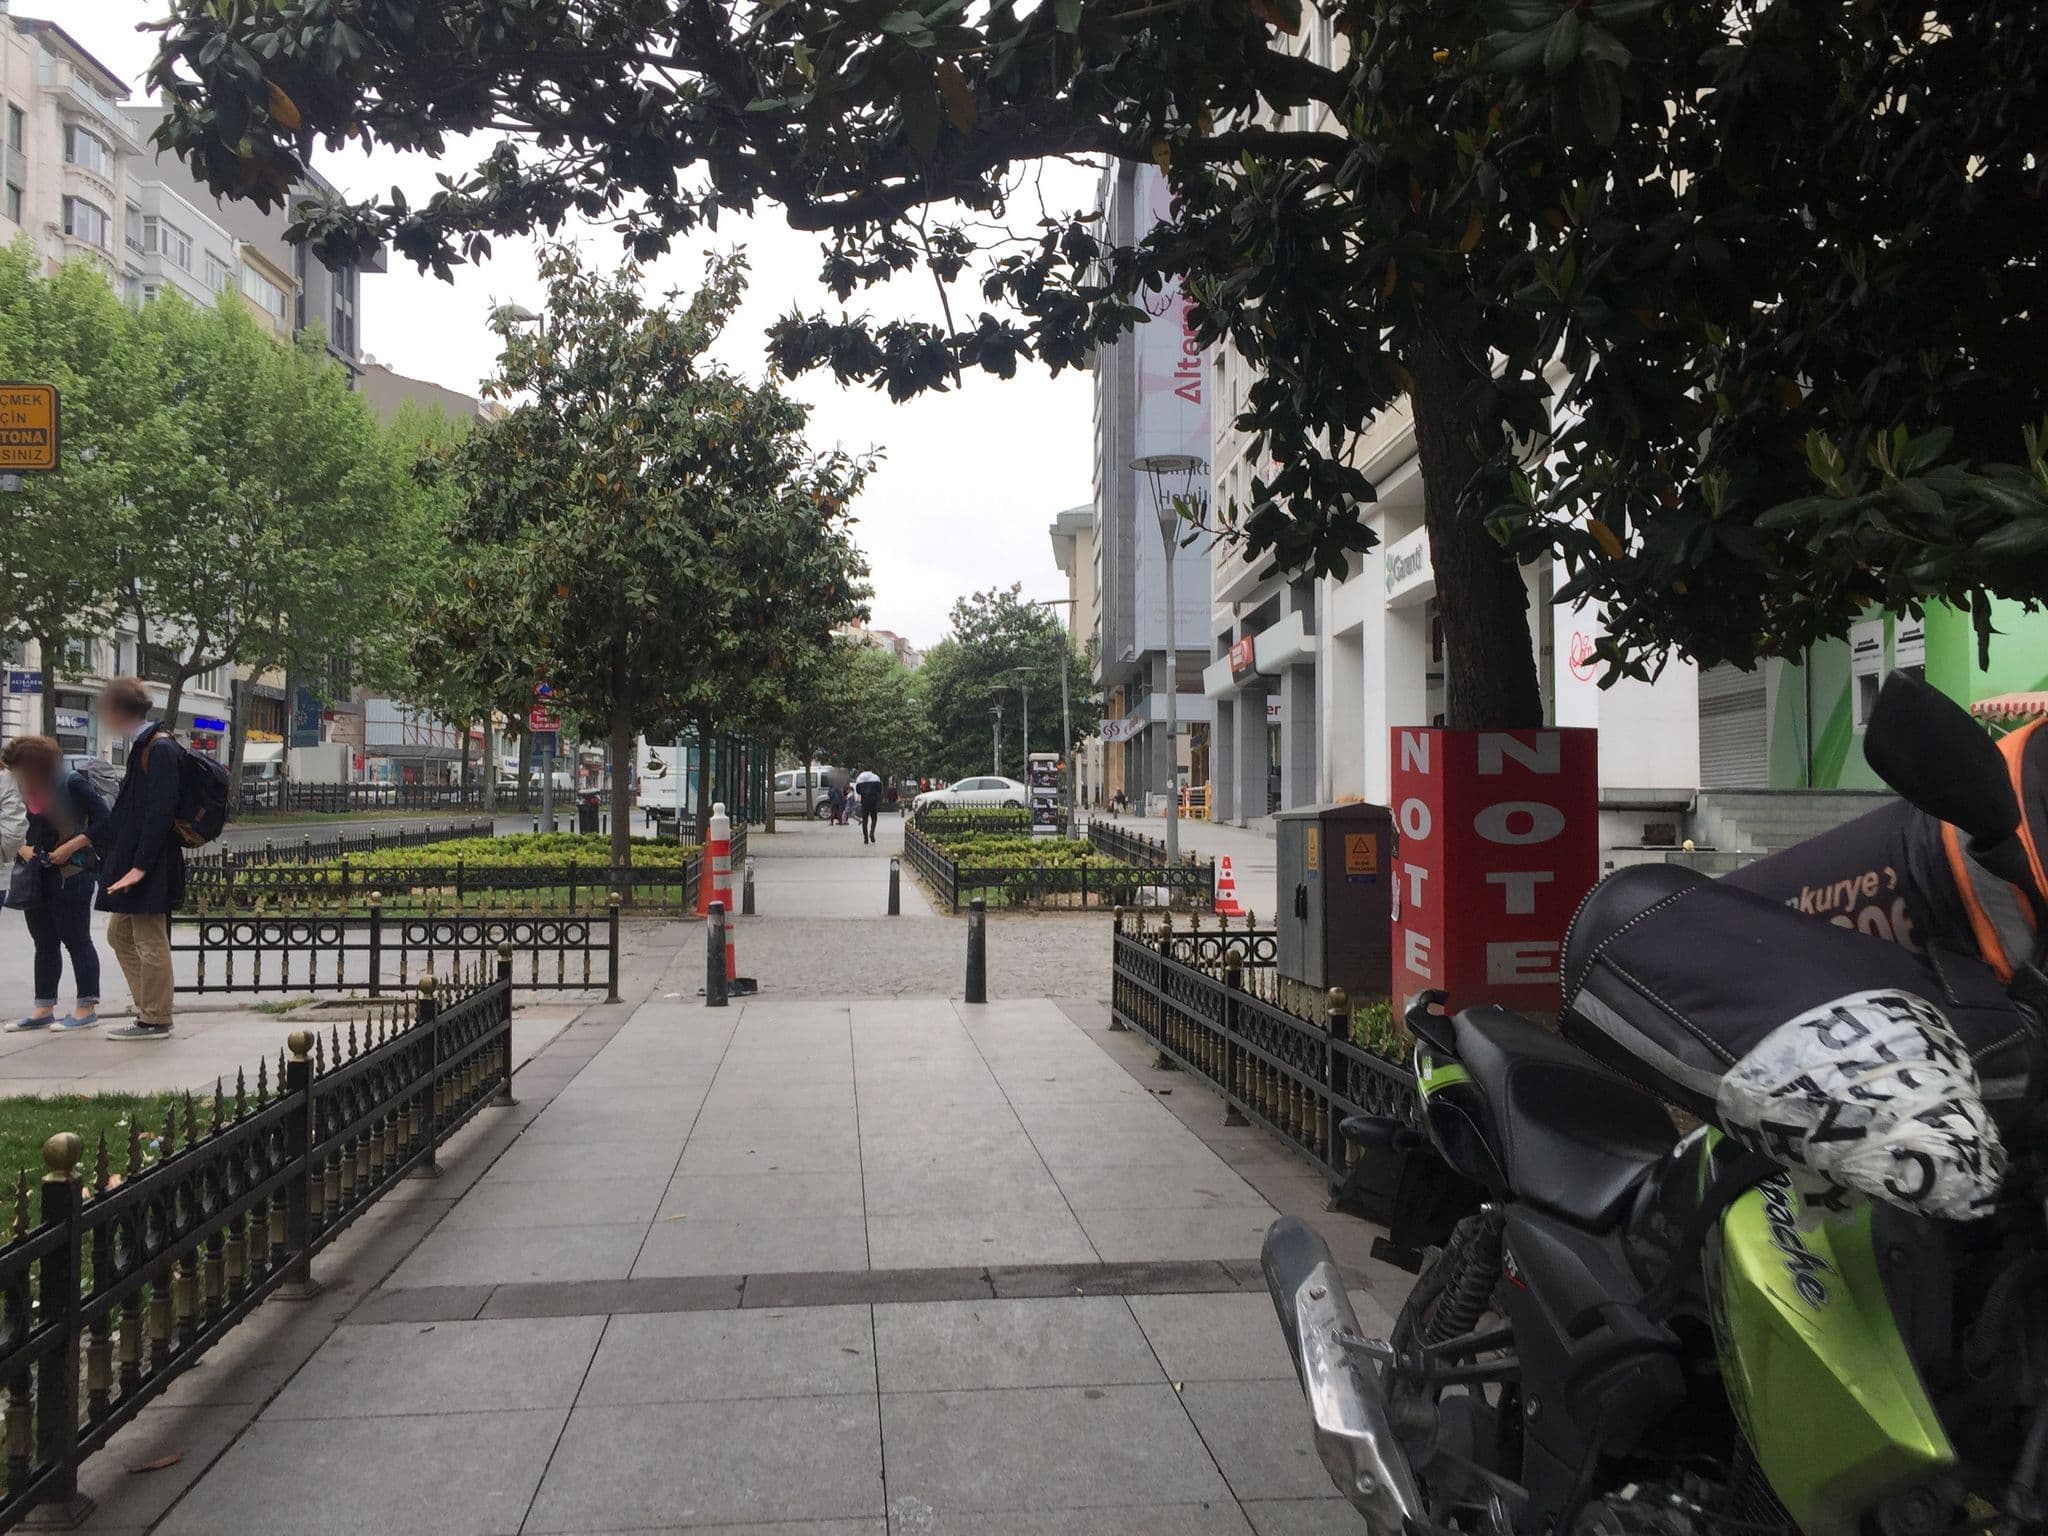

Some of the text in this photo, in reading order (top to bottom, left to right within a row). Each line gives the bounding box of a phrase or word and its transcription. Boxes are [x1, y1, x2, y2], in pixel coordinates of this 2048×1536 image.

[1173, 294, 1201, 405] Altern
[1400, 731, 1432, 1005] NOTE
[1474, 732, 1566, 984] NOTE
